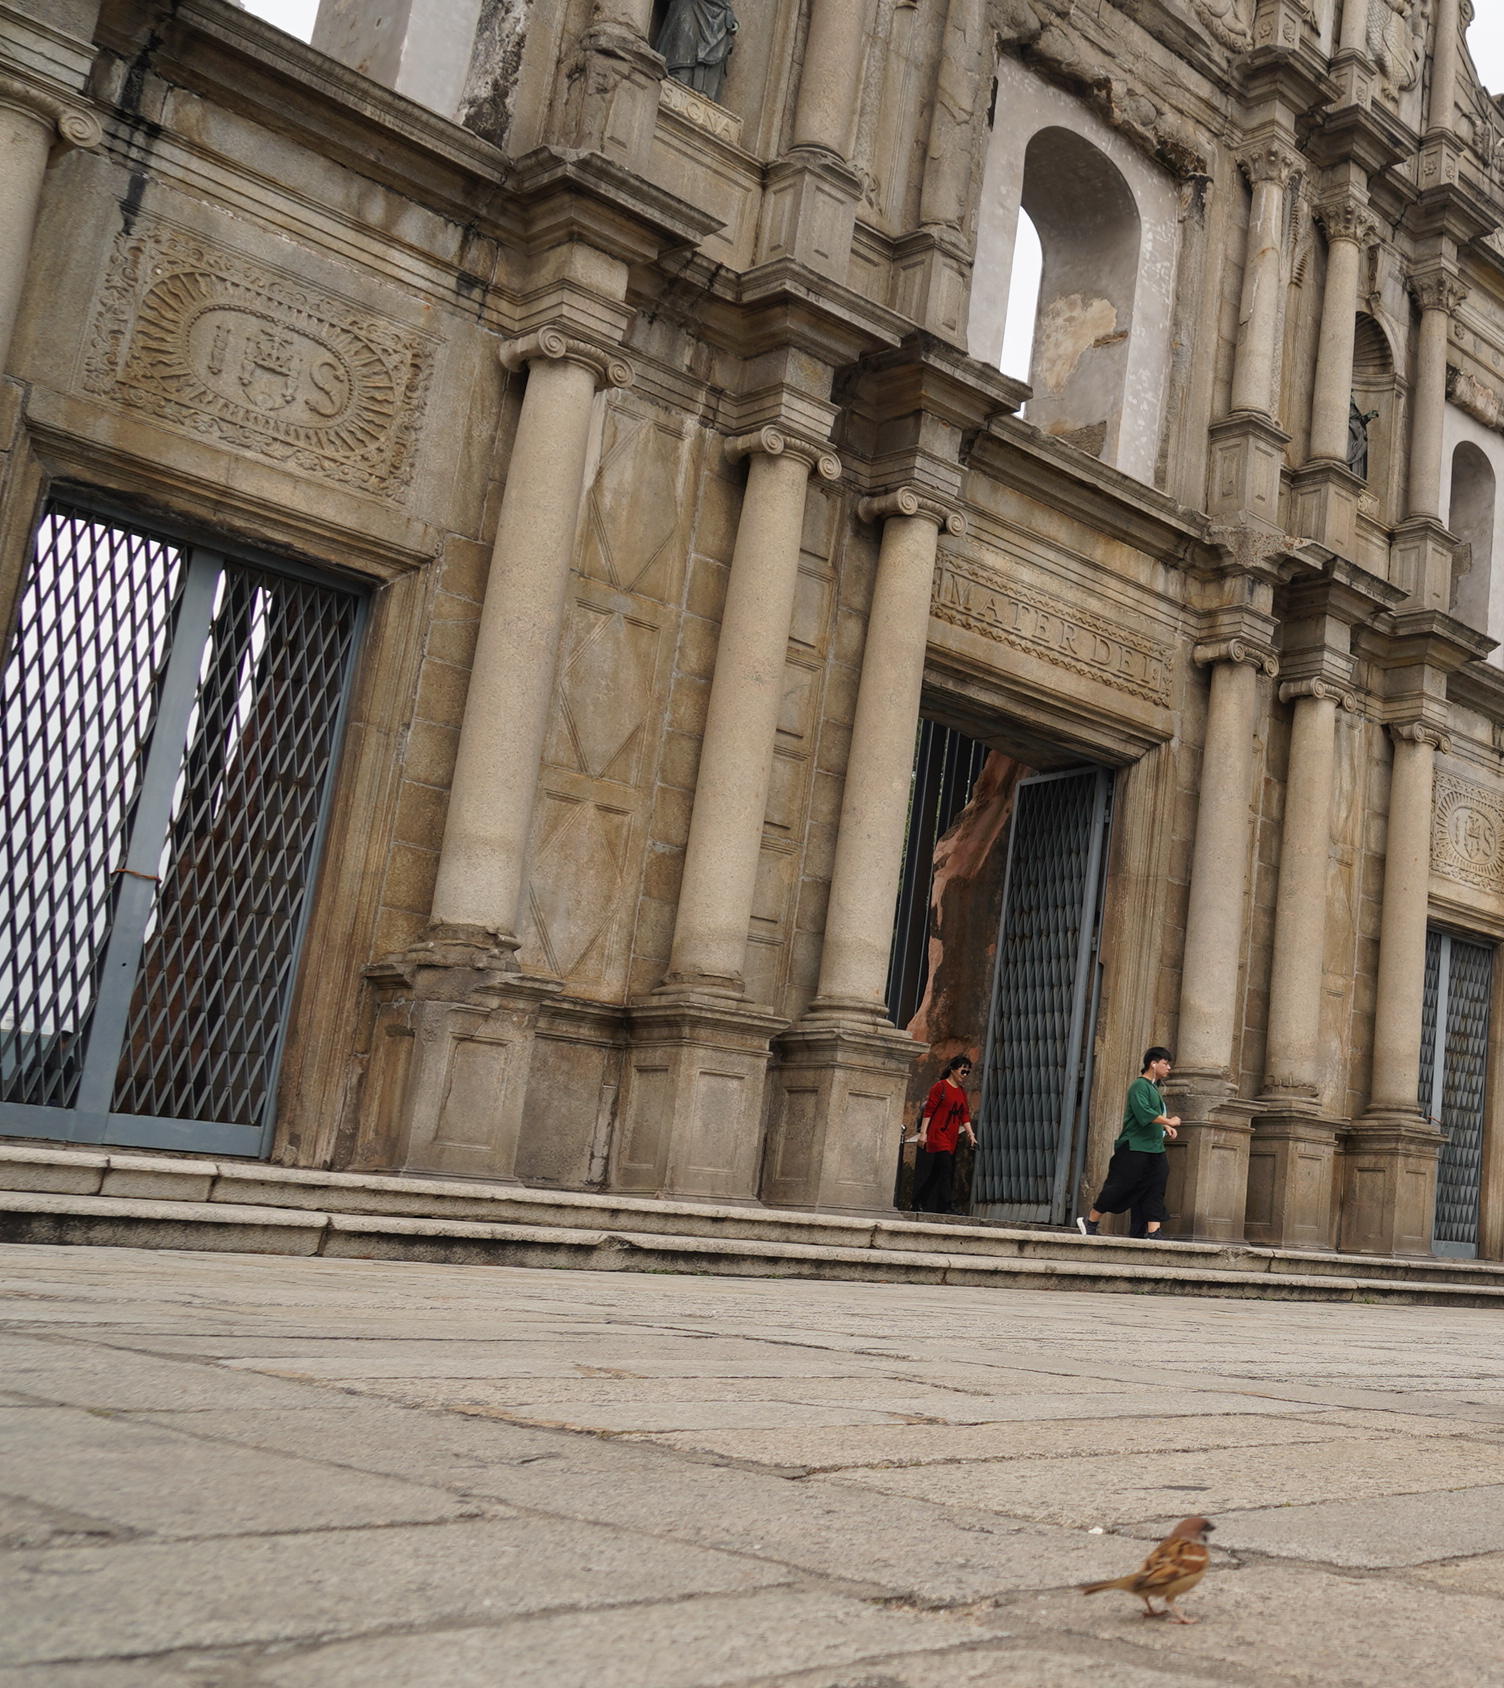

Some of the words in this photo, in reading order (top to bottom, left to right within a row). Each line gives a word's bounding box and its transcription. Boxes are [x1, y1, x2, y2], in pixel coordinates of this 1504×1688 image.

[207, 324, 347, 419] IHS
[946, 572, 1079, 656] MATER
[1089, 633, 1153, 685] DEI
